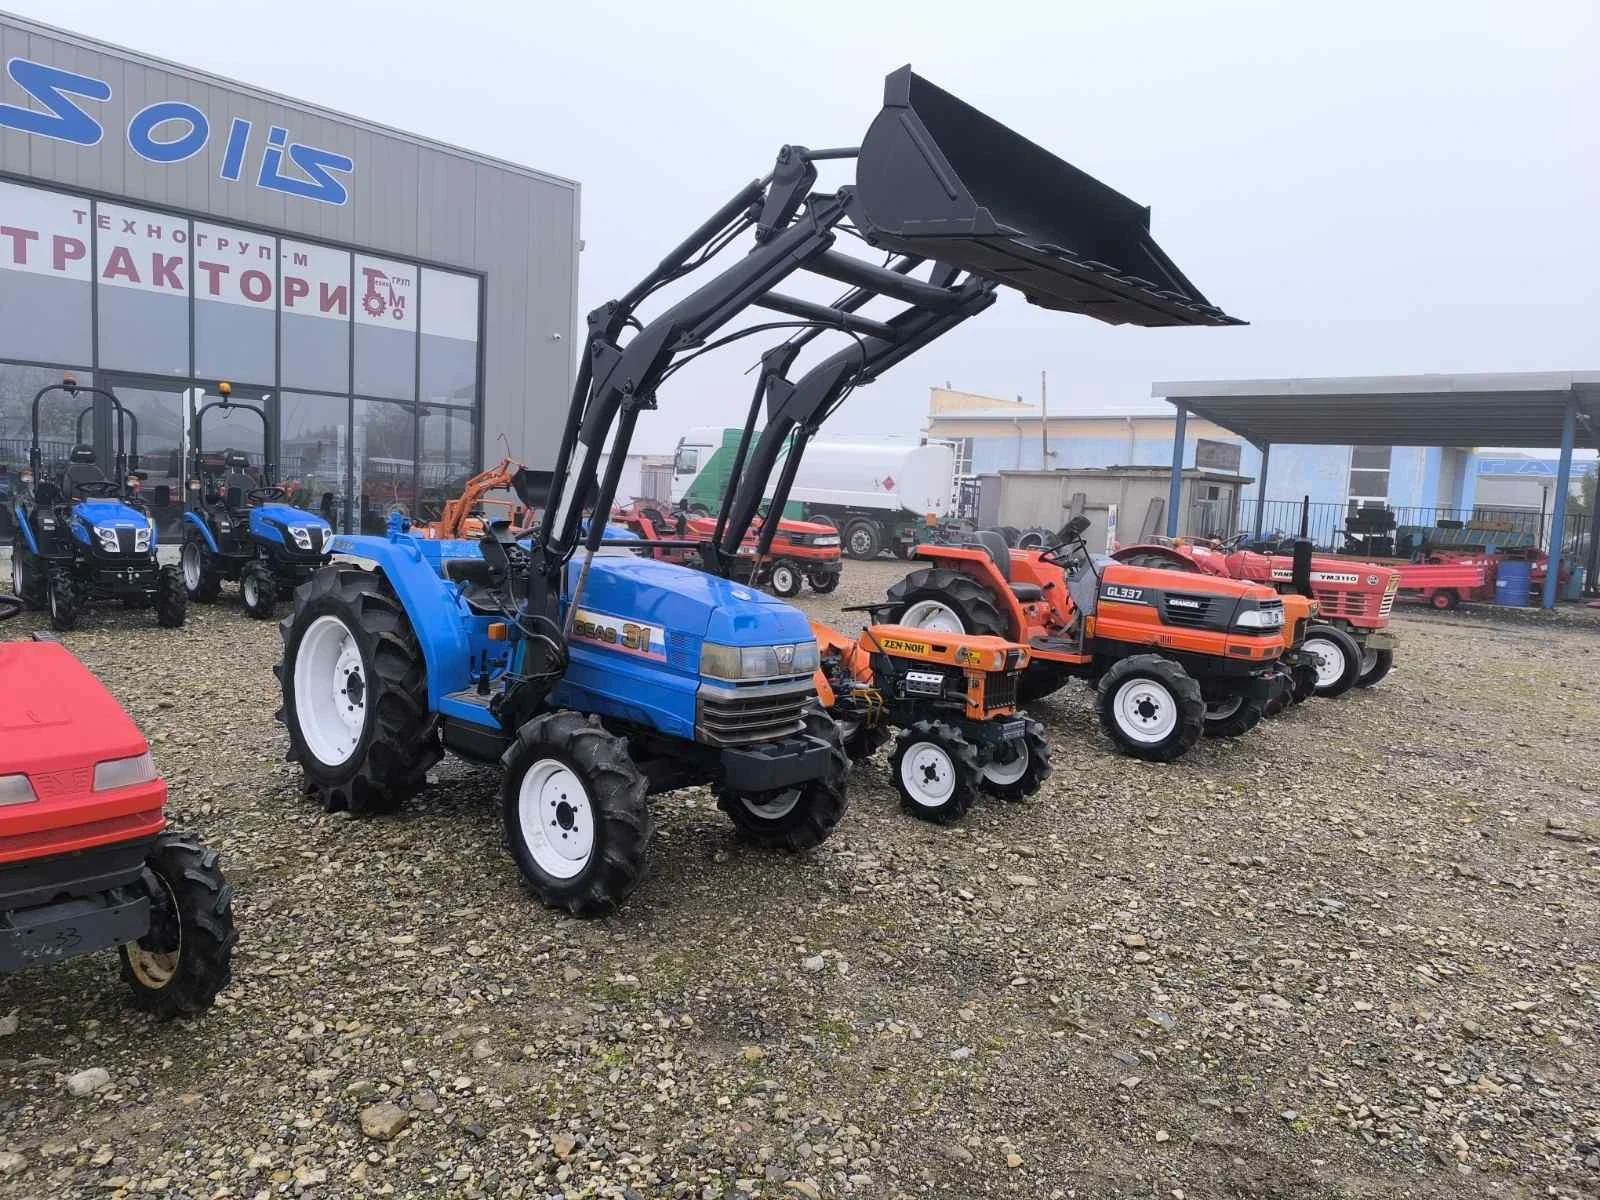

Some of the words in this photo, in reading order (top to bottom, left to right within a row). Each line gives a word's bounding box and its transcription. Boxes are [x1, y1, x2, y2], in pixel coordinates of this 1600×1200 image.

[0, 225, 348, 315] ТРАКТОРИ
[1320, 574, 1357, 582] YM3110
[1107, 586, 1143, 600] GL337
[622, 623, 651, 652] 31
[884, 639, 925, 653] ZEN-NOH
